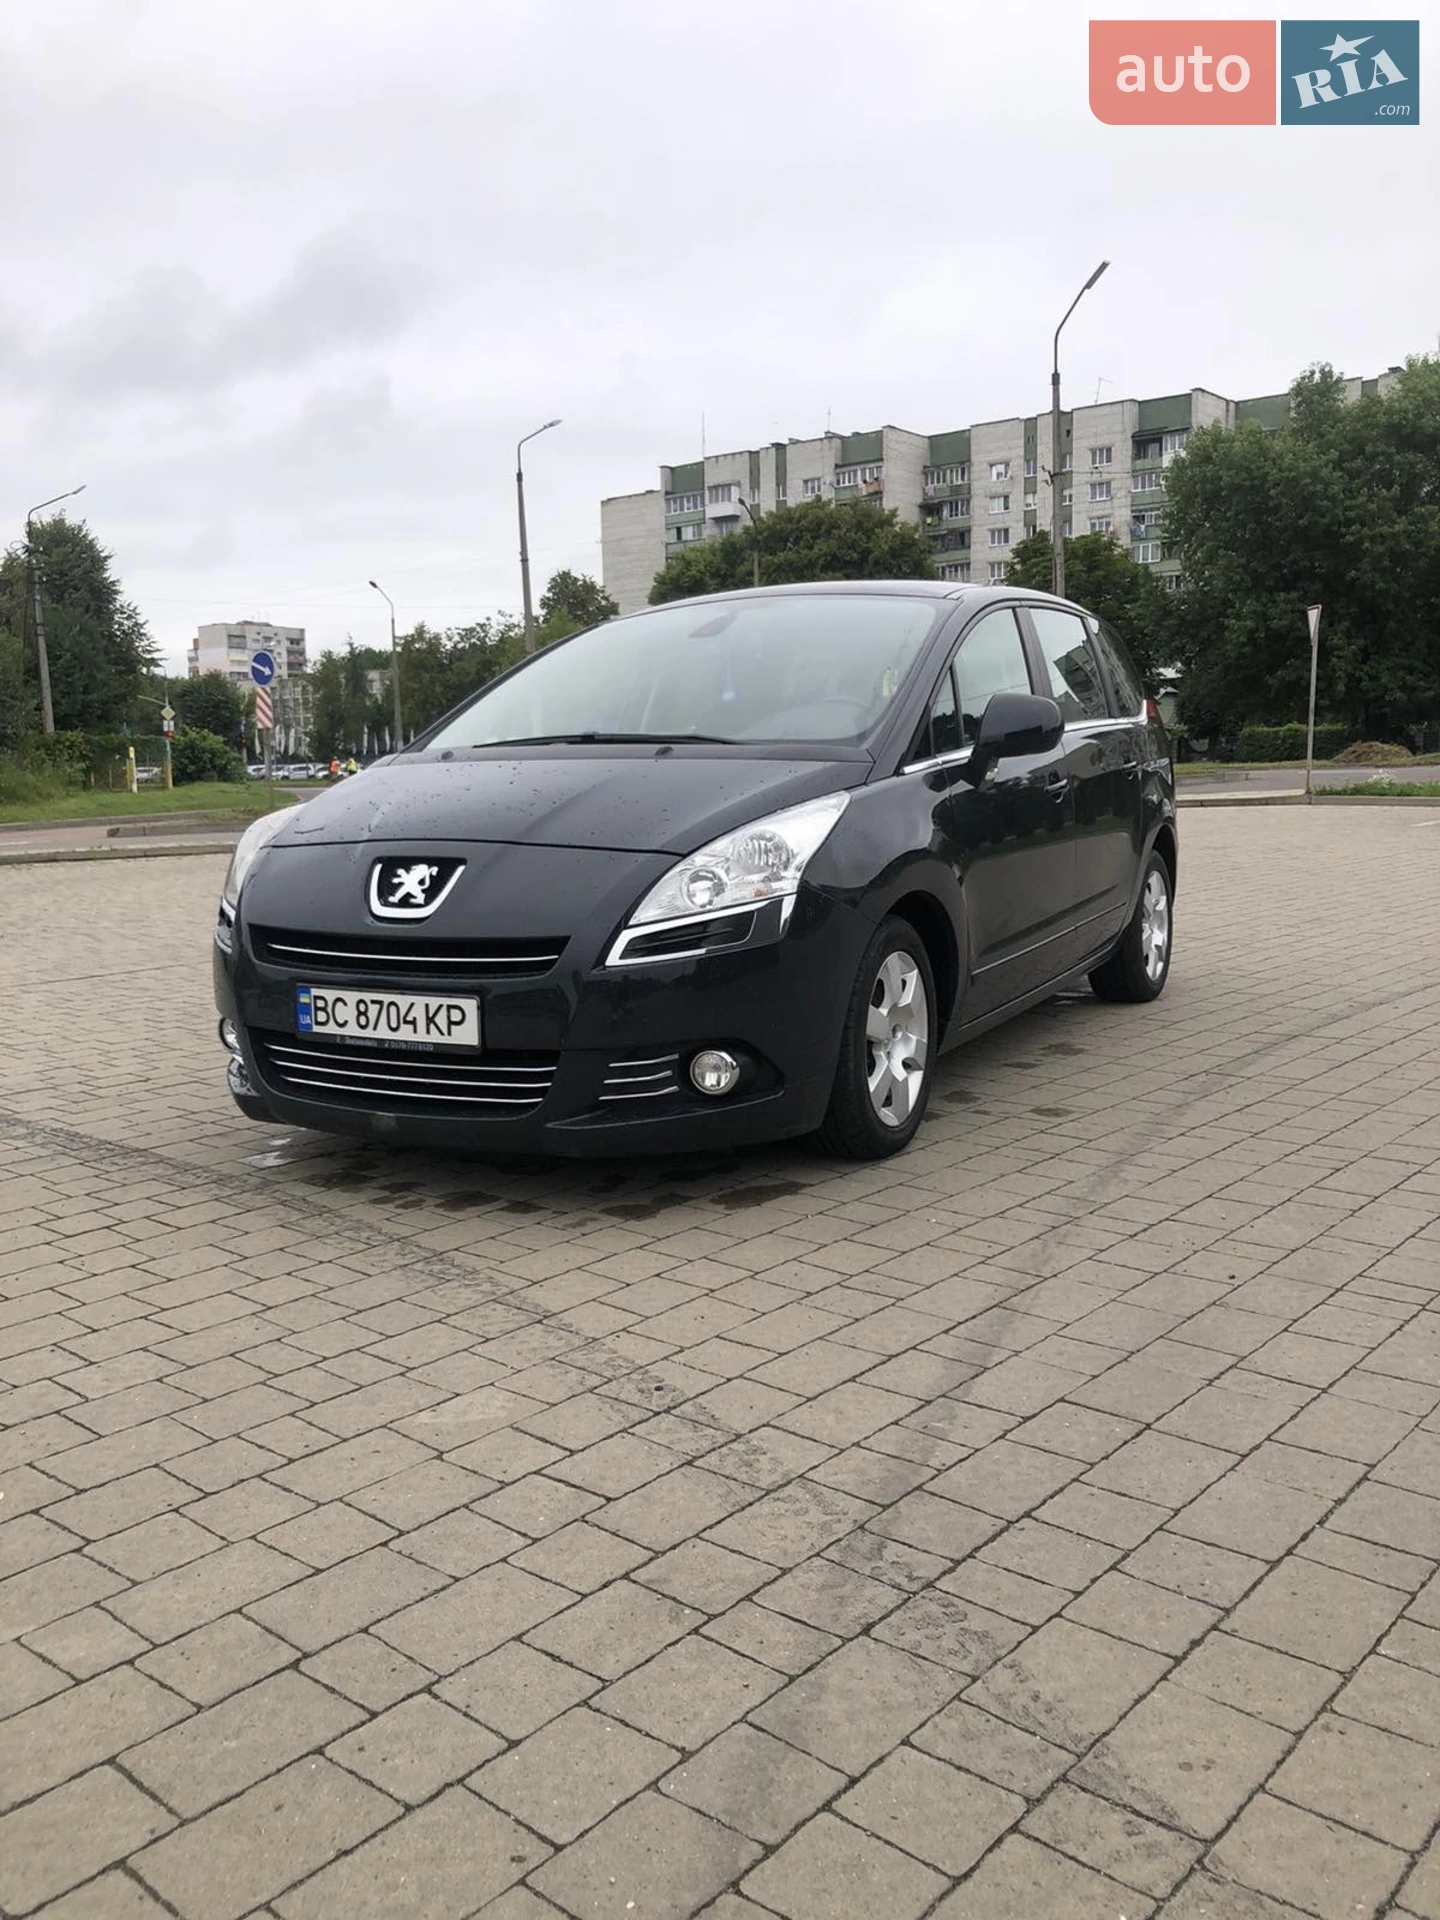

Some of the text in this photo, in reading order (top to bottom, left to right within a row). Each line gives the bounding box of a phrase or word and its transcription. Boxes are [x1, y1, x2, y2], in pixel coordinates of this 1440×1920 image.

[300, 1014, 311, 1025] UA
[313, 995, 466, 1036] BC 8704 KP
